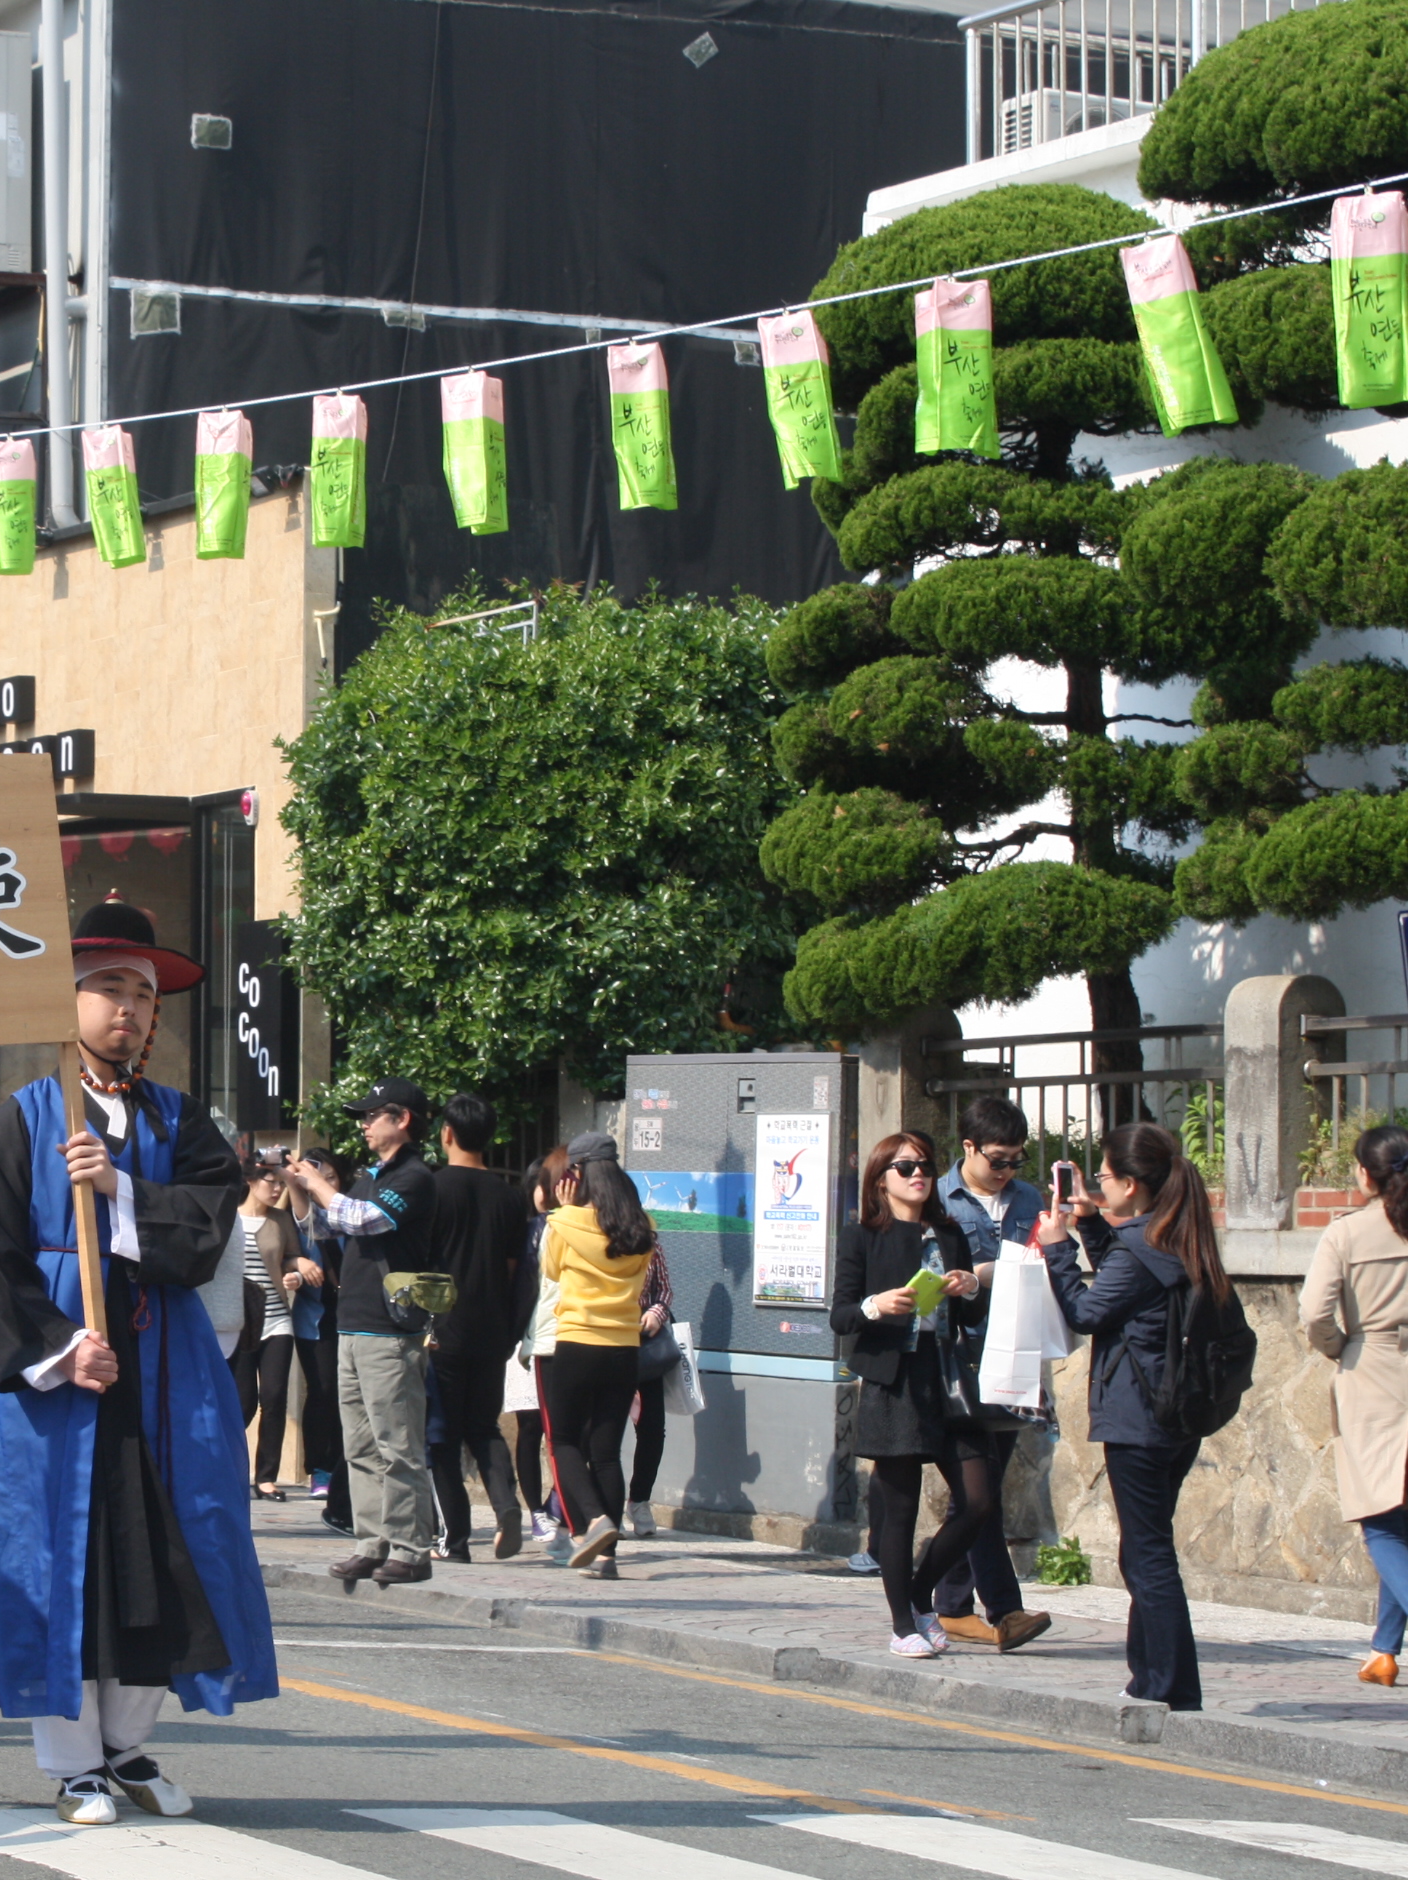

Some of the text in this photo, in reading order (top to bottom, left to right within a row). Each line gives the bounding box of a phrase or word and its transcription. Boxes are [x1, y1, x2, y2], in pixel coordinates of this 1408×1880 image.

[1342, 270, 1386, 314] 부산
[943, 337, 980, 377] 부산
[772, 372, 813, 411] 부산
[618, 402, 652, 437] 부산
[311, 445, 342, 478] 부산
[95, 475, 122, 505] 부산
[639, 1130, 661, 1149] 15-2
[770, 1264, 822, 1279] 서라벌대학교
